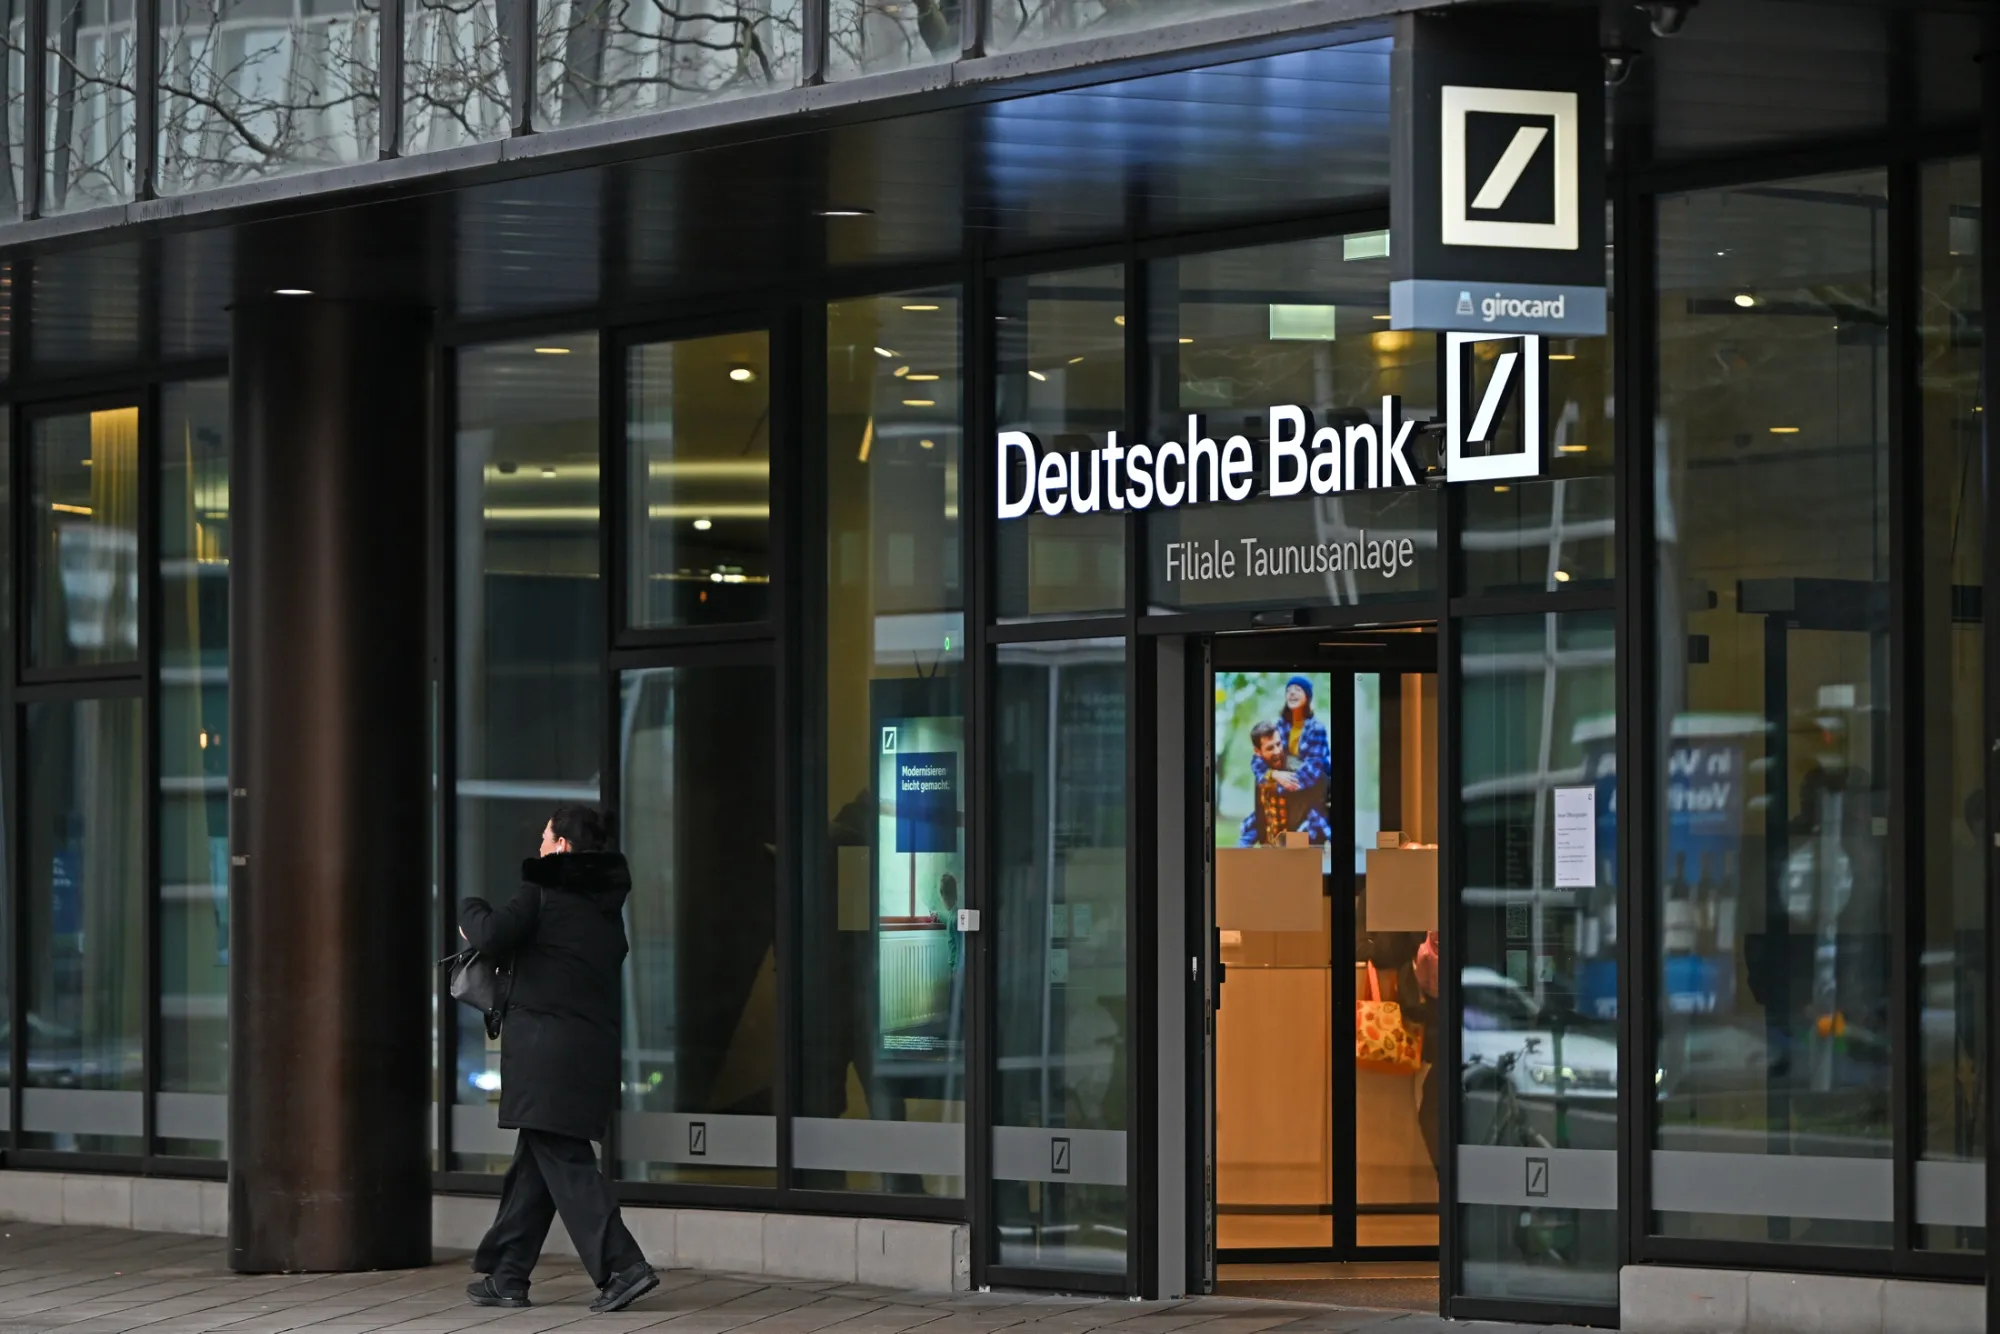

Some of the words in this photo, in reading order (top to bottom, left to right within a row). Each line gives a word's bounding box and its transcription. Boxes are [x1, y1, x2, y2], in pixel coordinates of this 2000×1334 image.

[1481, 292, 1566, 322] girocard
[998, 414, 1254, 519] Deutsche
[1269, 395, 1417, 497] Bank
[1166, 540, 1236, 582] Filiale
[1240, 529, 1414, 578] Taunusanlage
[901, 779, 920, 791] leicht
[920, 779, 951, 793] gemacht.
[902, 765, 947, 777] Modernisieren
